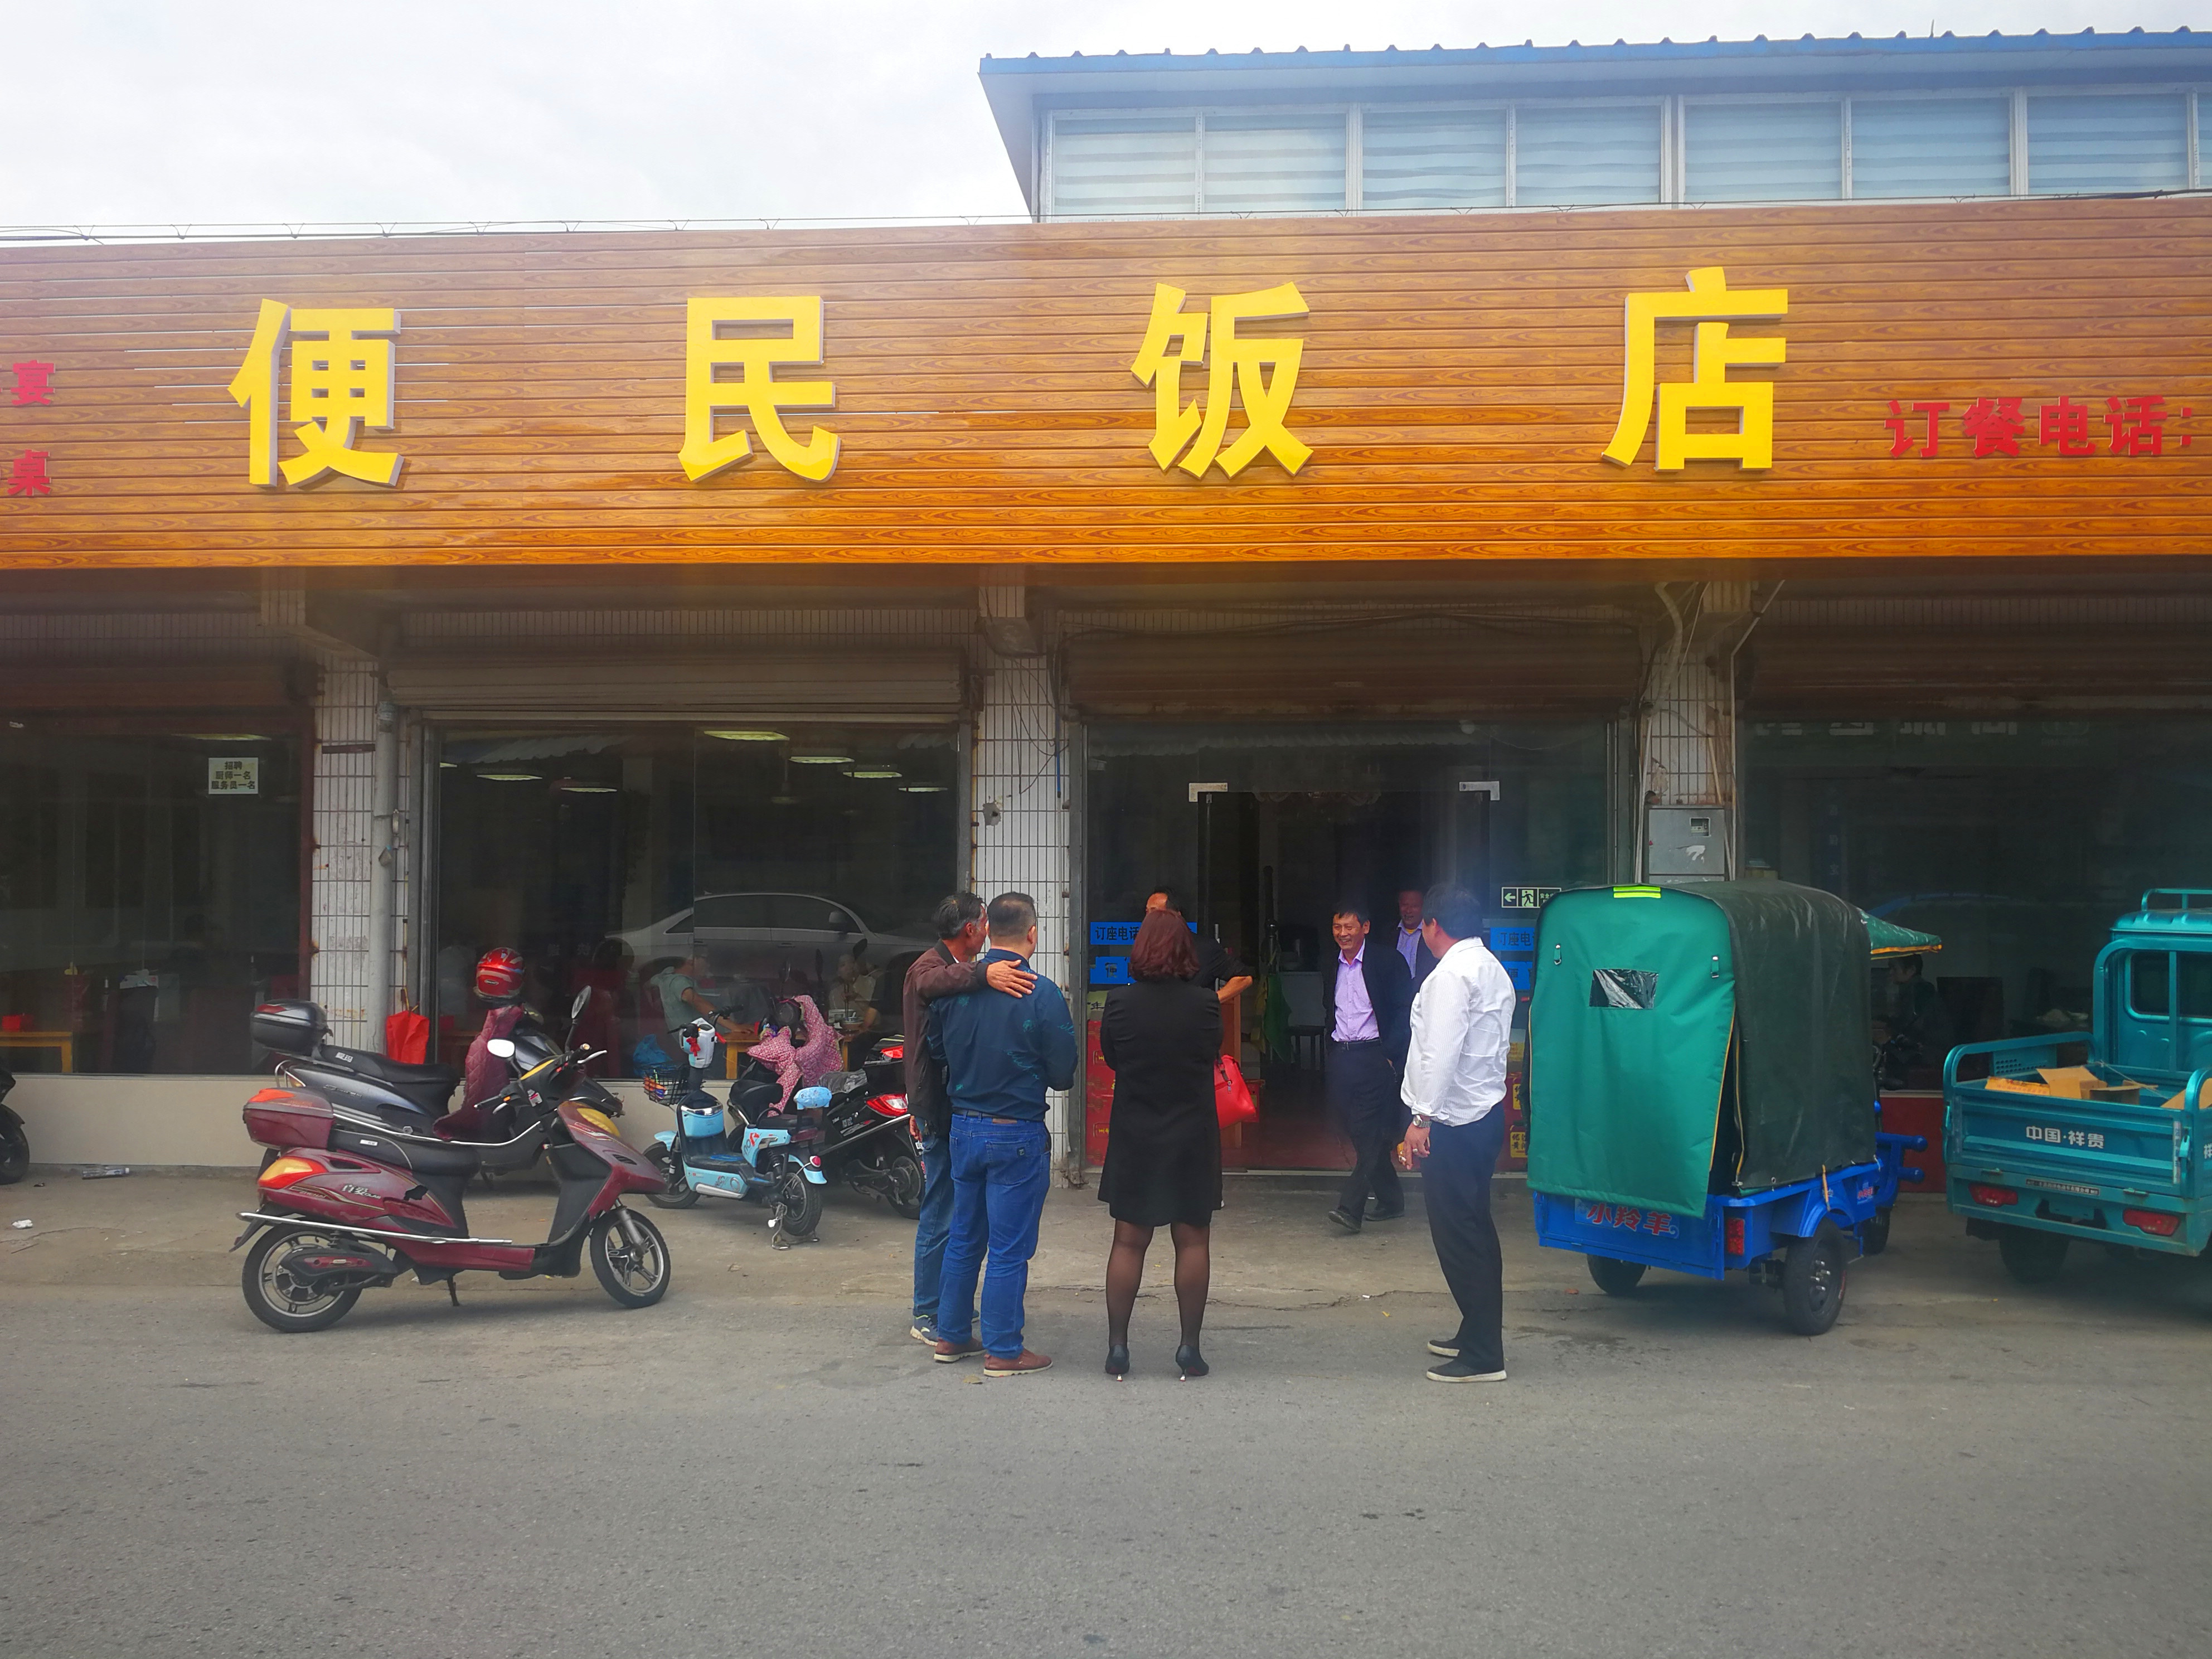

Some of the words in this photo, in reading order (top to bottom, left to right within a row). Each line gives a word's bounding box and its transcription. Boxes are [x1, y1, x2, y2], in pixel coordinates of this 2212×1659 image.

[10, 360, 55, 405] 宴
[226, 265, 1788, 487] 便民饭店
[7, 449, 51, 496] 桌
[216, 771, 250, 779] 厨师一名
[225, 761, 242, 770] 招聘
[211, 781, 255, 789] 服务员一名
[1497, 932, 1535, 946] 订座电
[1587, 1202, 1671, 1236] 小羚羊
